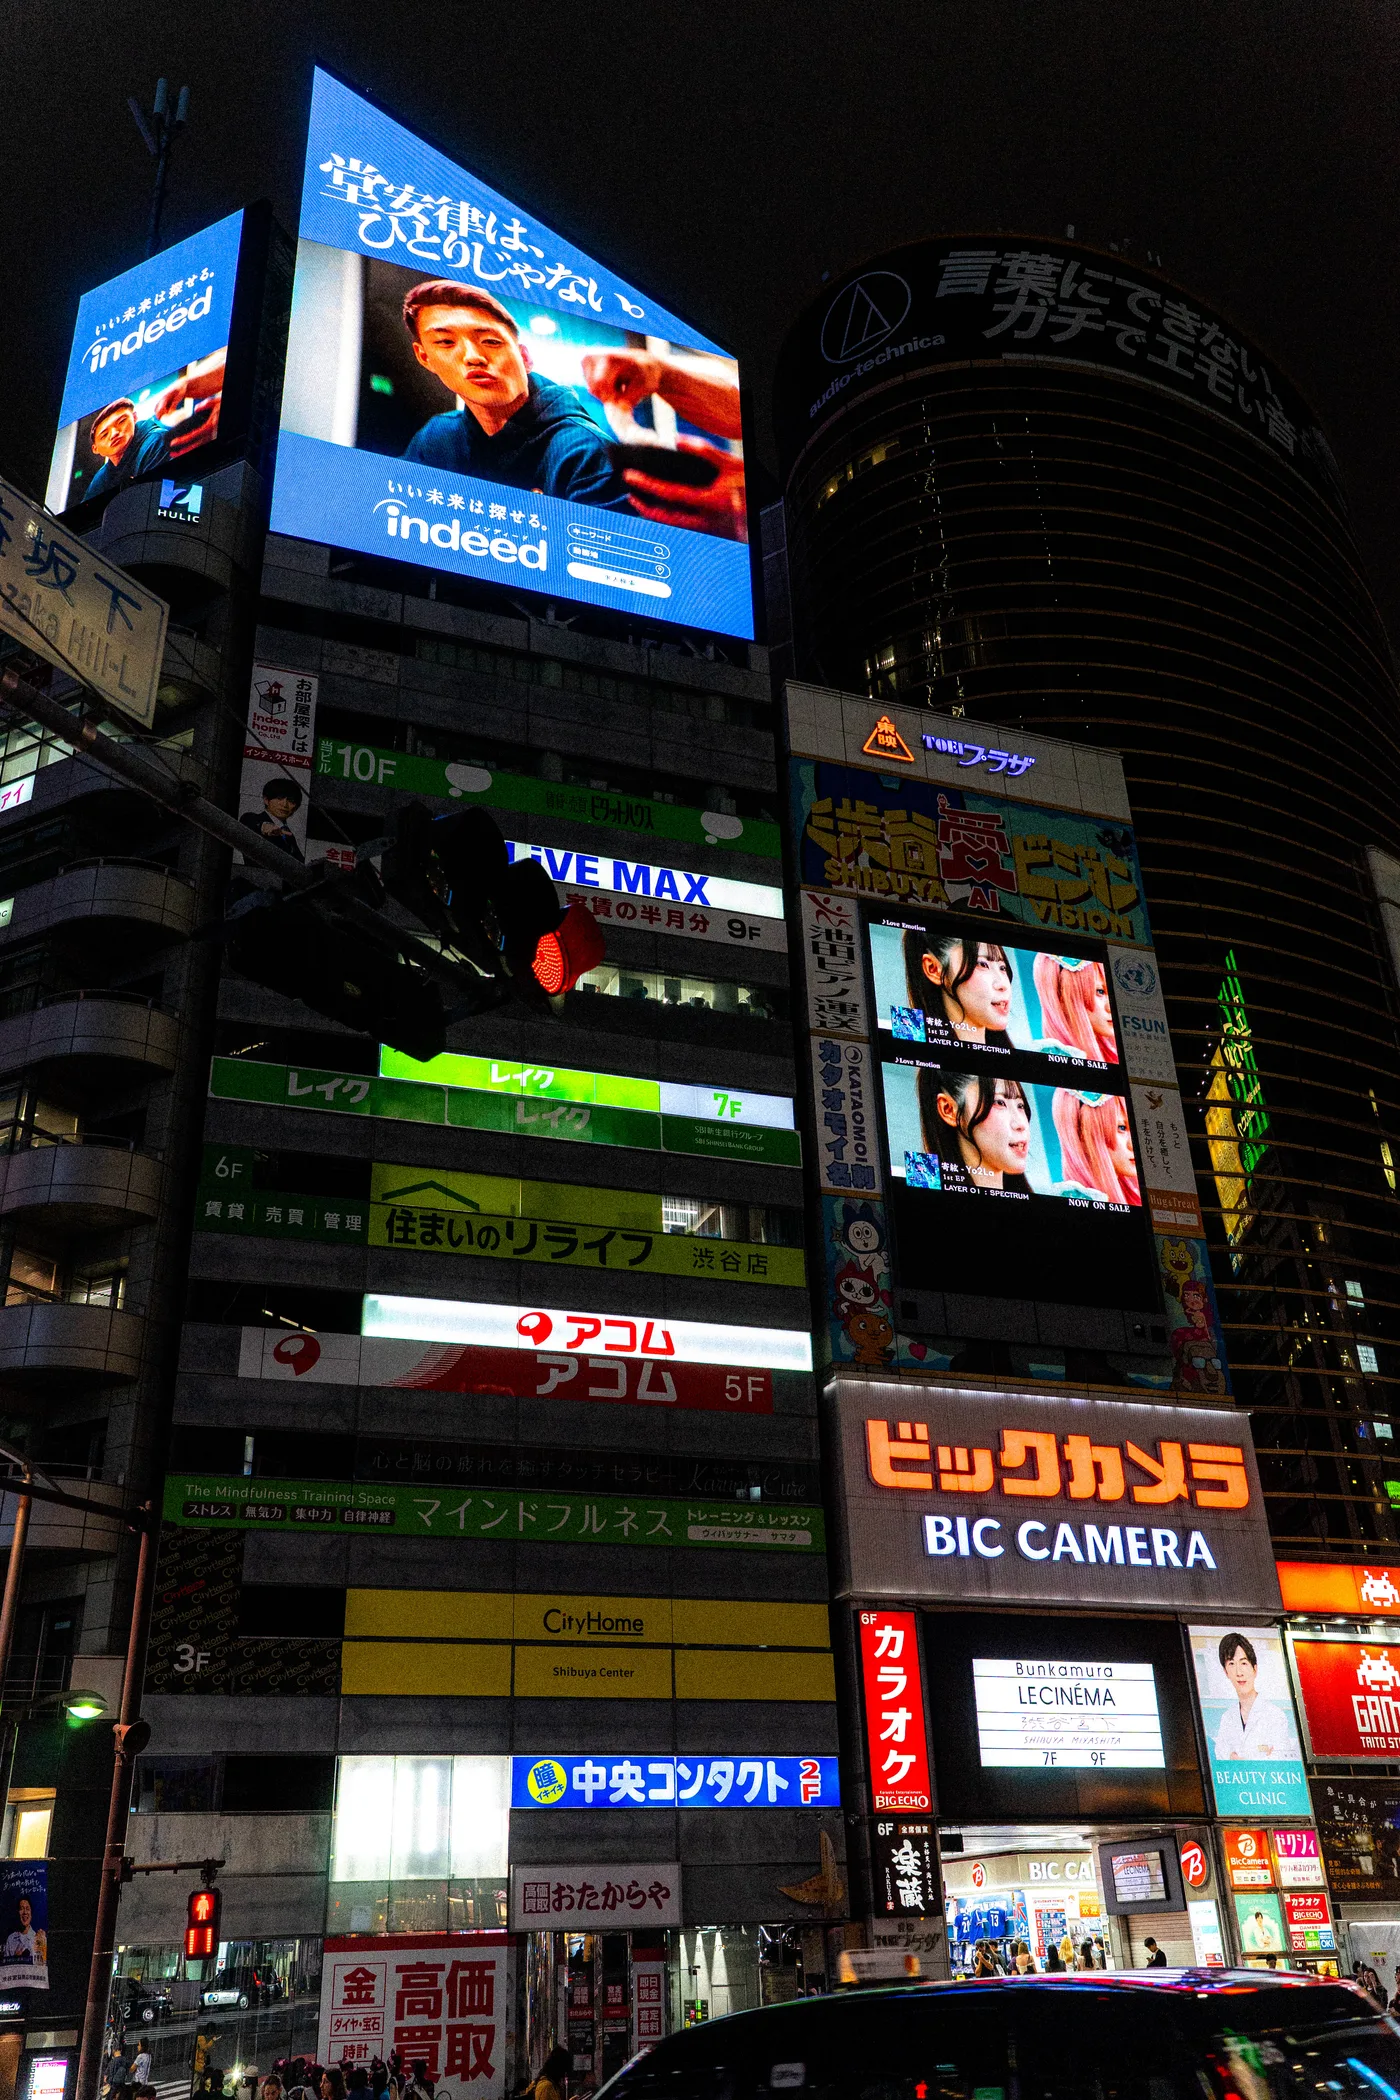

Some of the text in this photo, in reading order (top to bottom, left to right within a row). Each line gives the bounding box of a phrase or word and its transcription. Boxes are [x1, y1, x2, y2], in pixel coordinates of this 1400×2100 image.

[319, 152, 545, 259] 堂安律は、
[358, 212, 645, 318] ひとりじゃない。
[95, 267, 215, 336] いい未来は探せる。
[85, 286, 213, 373] indeed
[935, 250, 1284, 410] 言葉にできない、
[809, 331, 946, 418] audio-technica
[157, 508, 200, 523] HULIC
[387, 479, 548, 531] いい未来は探せる。
[381, 501, 547, 572] indeed
[573, 527, 611, 542] キーワード
[291, 678, 313, 753] お部屋探しは
[252, 722, 287, 735] home
[246, 748, 310, 766] インデックスホーム
[319, 740, 333, 774] 当ビル
[337, 745, 397, 784] 10F
[921, 734, 1036, 778] TOEIプラザ
[590, 795, 655, 830] ピタットハウス
[613, 860, 711, 906] MAX
[823, 859, 1134, 939] SHIBUYA AI VISION
[727, 918, 761, 941] 9F
[885, 919, 926, 931] Love Emotion
[809, 924, 862, 1033] 池田ピアノ運送
[1122, 1015, 1165, 1034] FSUN
[928, 1037, 1011, 1055] LAYER SPECTRUM
[899, 1057, 941, 1069] Love Emotion
[1048, 1054, 1108, 1070] NOW ON SALE
[288, 1071, 370, 1103] レイク
[490, 1063, 555, 1089] レイク
[516, 1101, 591, 1130] レイク
[713, 1093, 742, 1118] 7F
[848, 1065, 868, 1163] KATAOMOI
[694, 1125, 764, 1142] SBI新生銀行グループ
[743, 1143, 765, 1152] GROUP
[215, 1156, 243, 1179] 6F
[944, 1184, 1029, 1201] LAYER SPECTRUM
[204, 1200, 362, 1232] 賃貸 売買 管理
[1068, 1198, 1130, 1213] NOW ON SALE
[385, 1207, 768, 1276] 住まいのリライフ 渋谷店
[566, 1316, 675, 1356] アコム
[535, 1354, 766, 1402] アコム 5F
[865, 1418, 1251, 1510] ビックカメラ
[185, 1484, 396, 1507] The Mindfulness Training Space
[187, 1503, 392, 1524] ストレス 無気力 集中力 自律神経
[412, 1497, 673, 1538] マインドフルネス
[771, 1532, 796, 1541] サマタ
[923, 1515, 1218, 1570] BIC CAMERA
[543, 1608, 644, 1636] CityHome
[861, 1613, 877, 1625] 6F
[173, 1643, 211, 1673] 3F
[552, 1666, 634, 1679] Shibuya Center
[1016, 1662, 1113, 1678] Bunkamura
[874, 1625, 916, 1785] カラオケ
[1024, 1735, 1121, 1745] SHIBUYA MIYASHITA
[1360, 1737, 1386, 1748] TAITO
[1042, 1752, 1106, 1766] 7F 9F
[533, 1762, 558, 1789] 瞳
[571, 1759, 821, 1804] 中央コンタクト 2F
[1217, 1771, 1302, 1785] BEAUTY SKIN
[535, 1782, 565, 1801] イキイキ
[1239, 1792, 1287, 1805] CLINIC
[877, 1823, 894, 1836] 6F
[901, 1825, 929, 1834] 全席個室
[1275, 1832, 1316, 1857] ゼクシィ
[1029, 1862, 1060, 1881] BIC
[1230, 1857, 1269, 1865] BicCamera
[885, 1867, 893, 1901] RAKUZO
[891, 1839, 925, 1911] 楽蔵
[551, 1880, 671, 1912] おたからや
[1291, 1897, 1320, 1906] カラオケ
[991, 1914, 999, 1927] 13
[1293, 1940, 1306, 1949] OK!
[1320, 1939, 1334, 1948] OK!
[342, 1966, 377, 2005] 金
[394, 1959, 496, 2021] 高価
[639, 1976, 658, 1988] 即日
[639, 1988, 660, 2001] 現金
[334, 2016, 381, 2033] ダイヤ・宝石
[569, 2009, 593, 2017] おたからや
[639, 2009, 660, 2021] 査定
[639, 2022, 660, 2034] 無料
[342, 2043, 369, 2060] 時計
[392, 2022, 496, 2083] 買取
